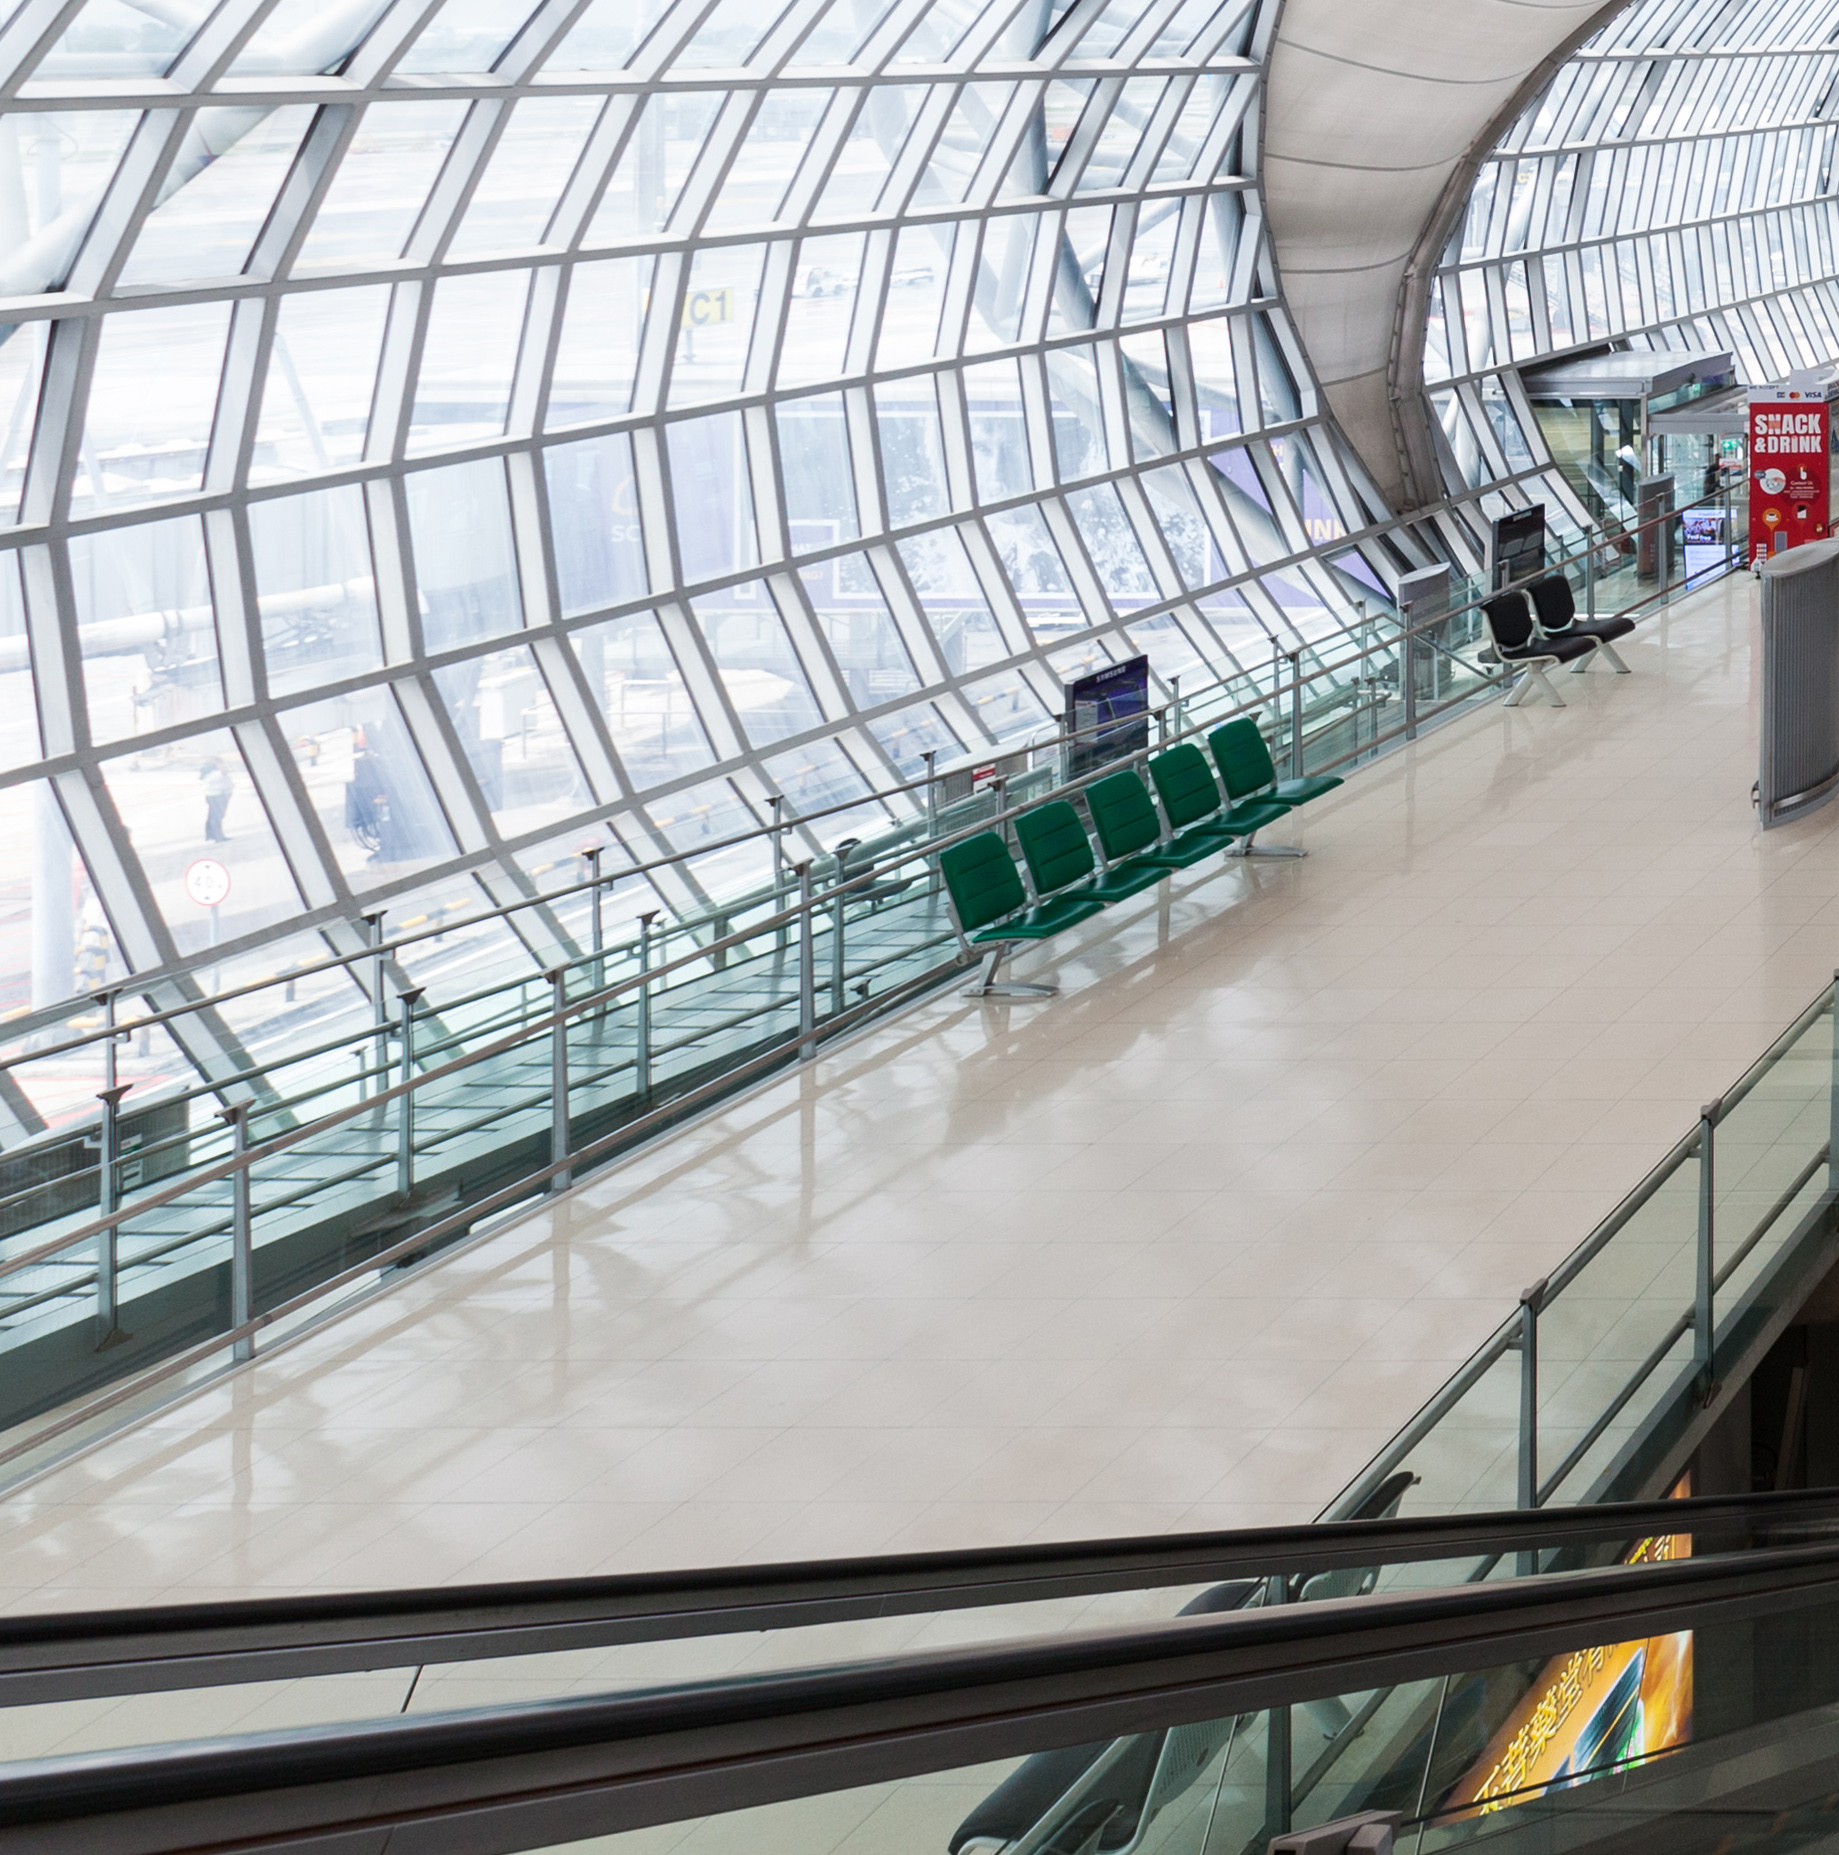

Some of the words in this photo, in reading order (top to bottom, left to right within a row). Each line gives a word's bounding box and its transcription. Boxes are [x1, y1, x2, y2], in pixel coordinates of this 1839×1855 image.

[690, 291, 726, 325] C1
[1754, 414, 1822, 435] SNACK
[1096, 665, 1127, 683] SAMSUNG
